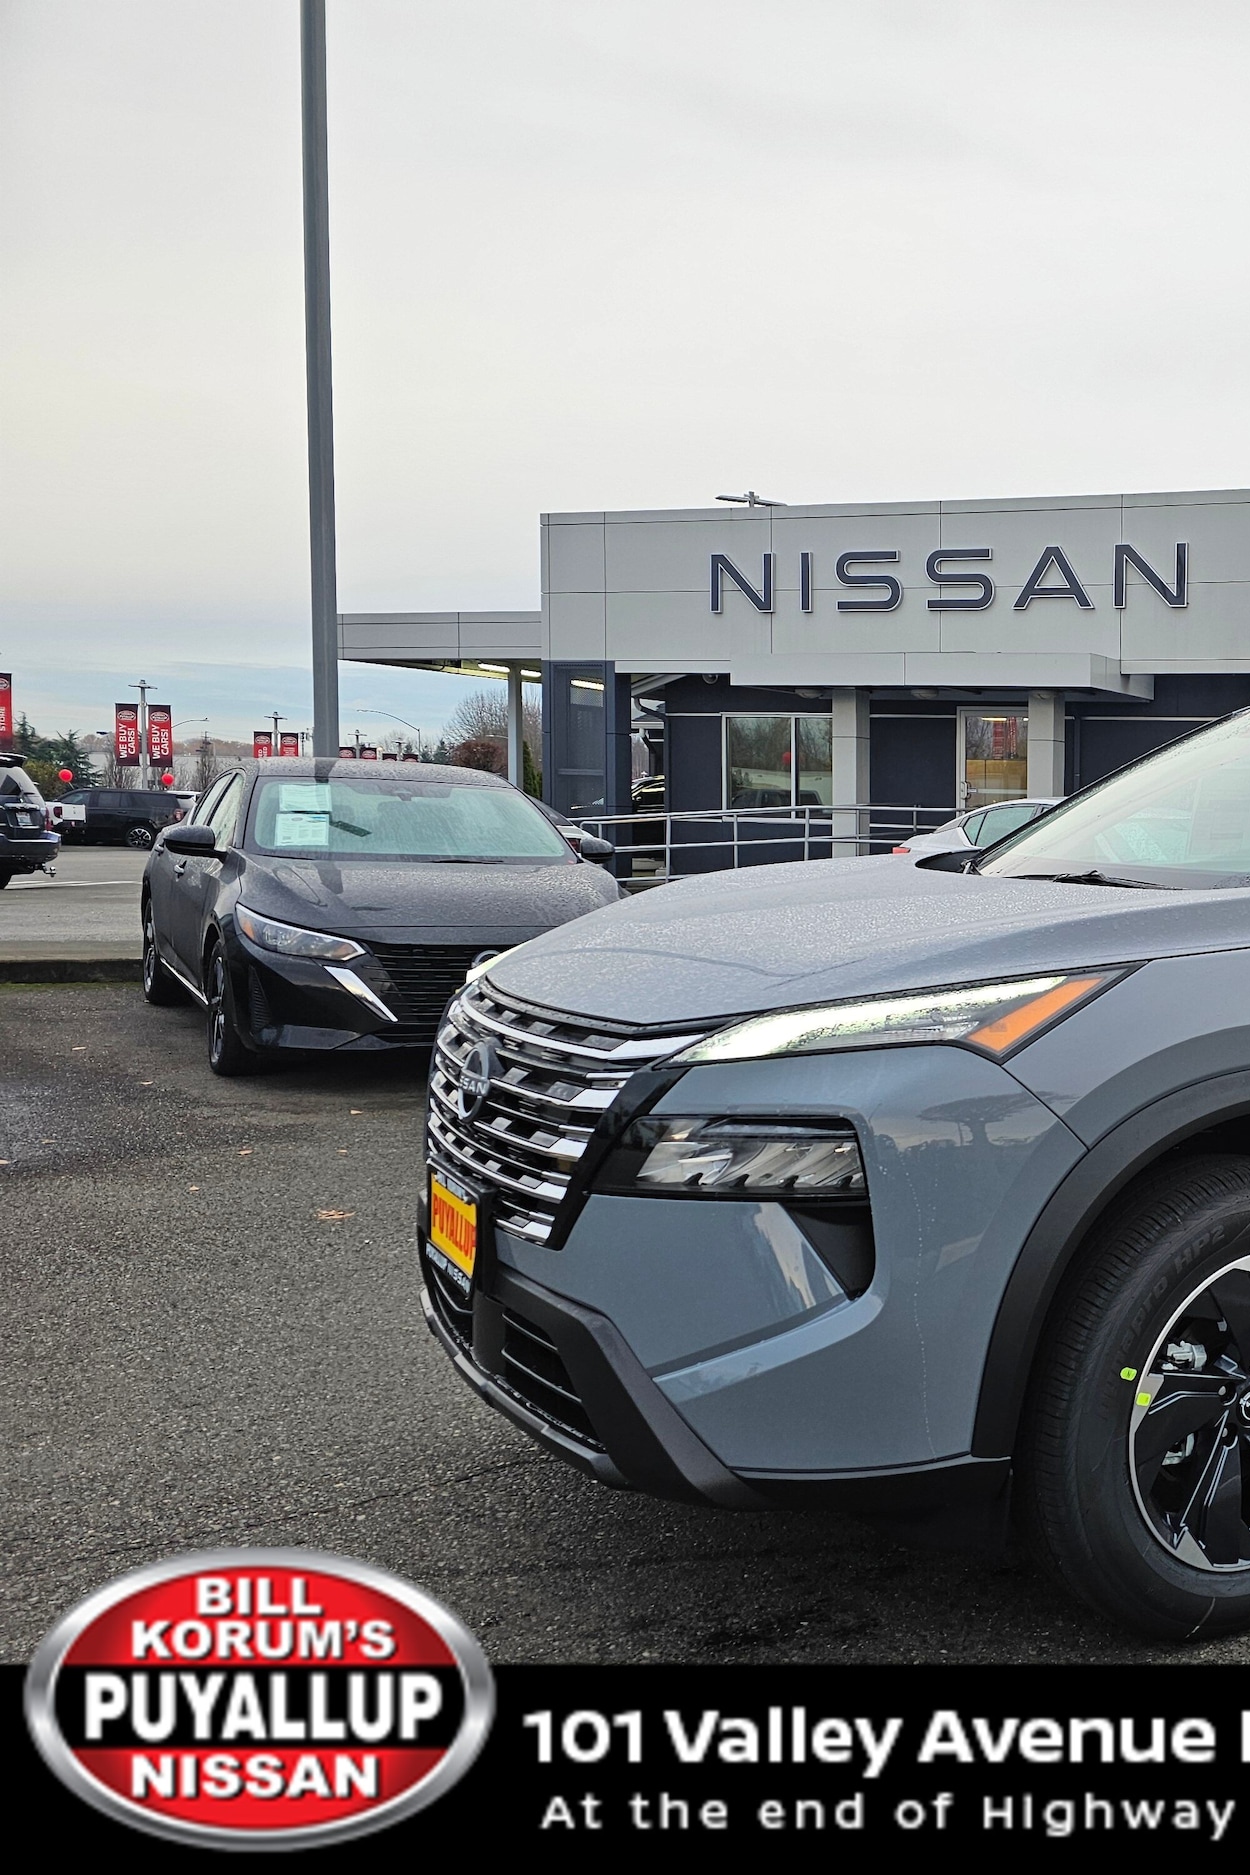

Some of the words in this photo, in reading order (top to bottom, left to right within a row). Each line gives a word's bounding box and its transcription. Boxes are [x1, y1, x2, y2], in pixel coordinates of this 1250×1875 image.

[709, 541, 1190, 614] NISSAN
[119, 723, 128, 742] BUY
[128, 727, 136, 755] CARS!
[151, 724, 160, 743] BUY
[161, 728, 169, 756] CARS!
[119, 744, 128, 759] WE
[152, 745, 161, 760] WE
